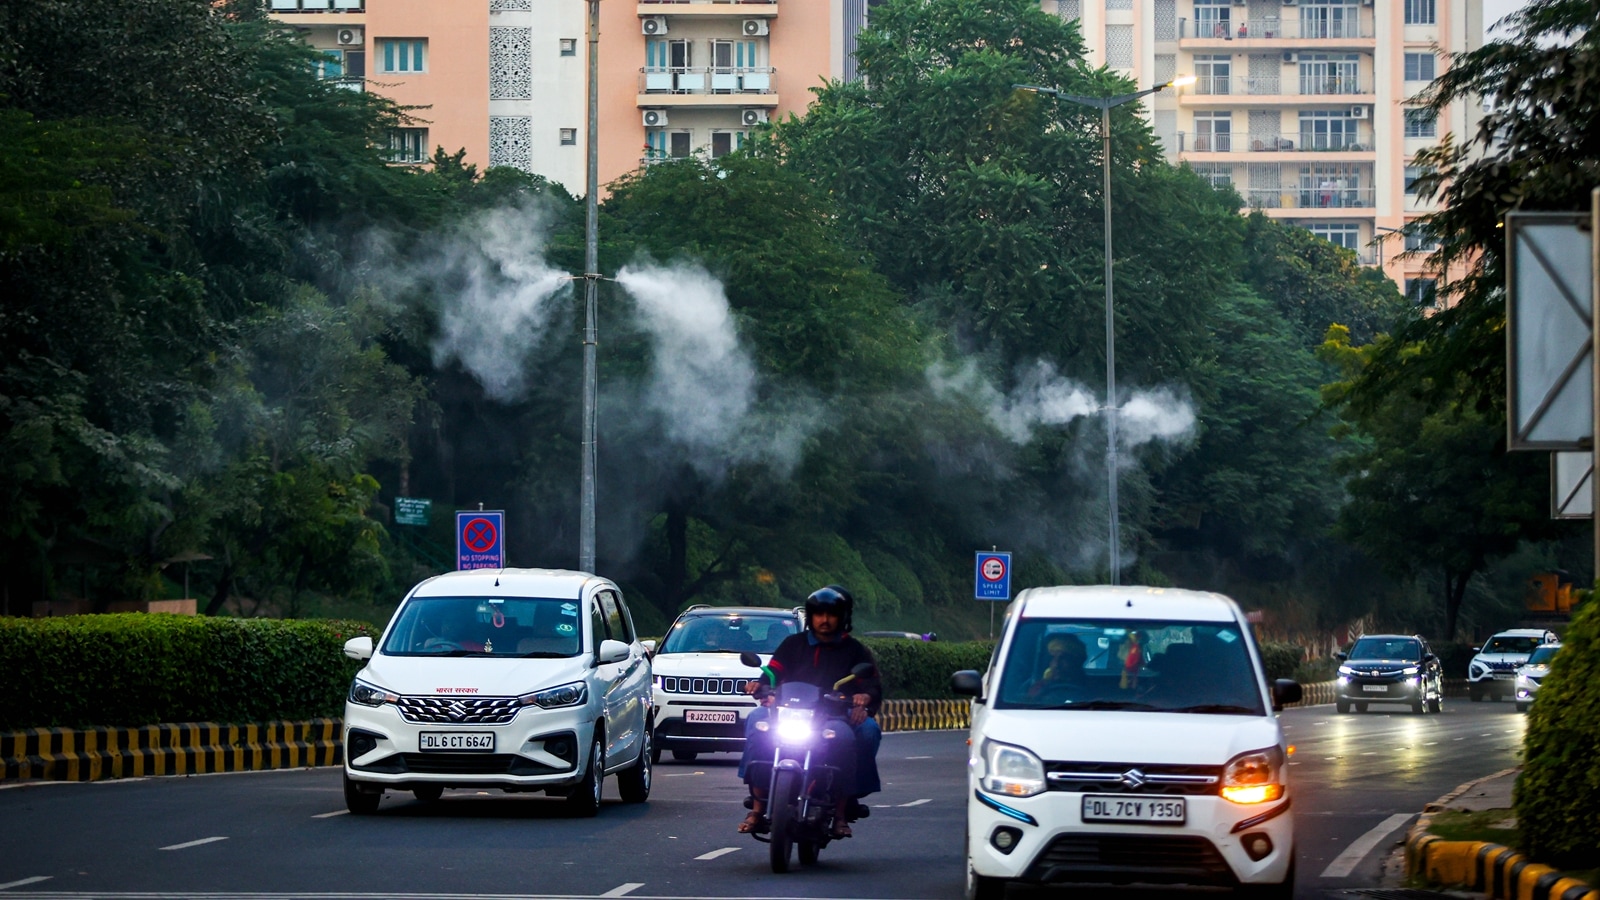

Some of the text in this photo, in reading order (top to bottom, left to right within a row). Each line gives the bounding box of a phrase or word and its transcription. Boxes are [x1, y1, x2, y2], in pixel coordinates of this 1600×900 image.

[690, 713, 735, 722] RJ22CC7002
[466, 736, 492, 747] 6647
[1093, 801, 1183, 818] DL 7CV 1350
